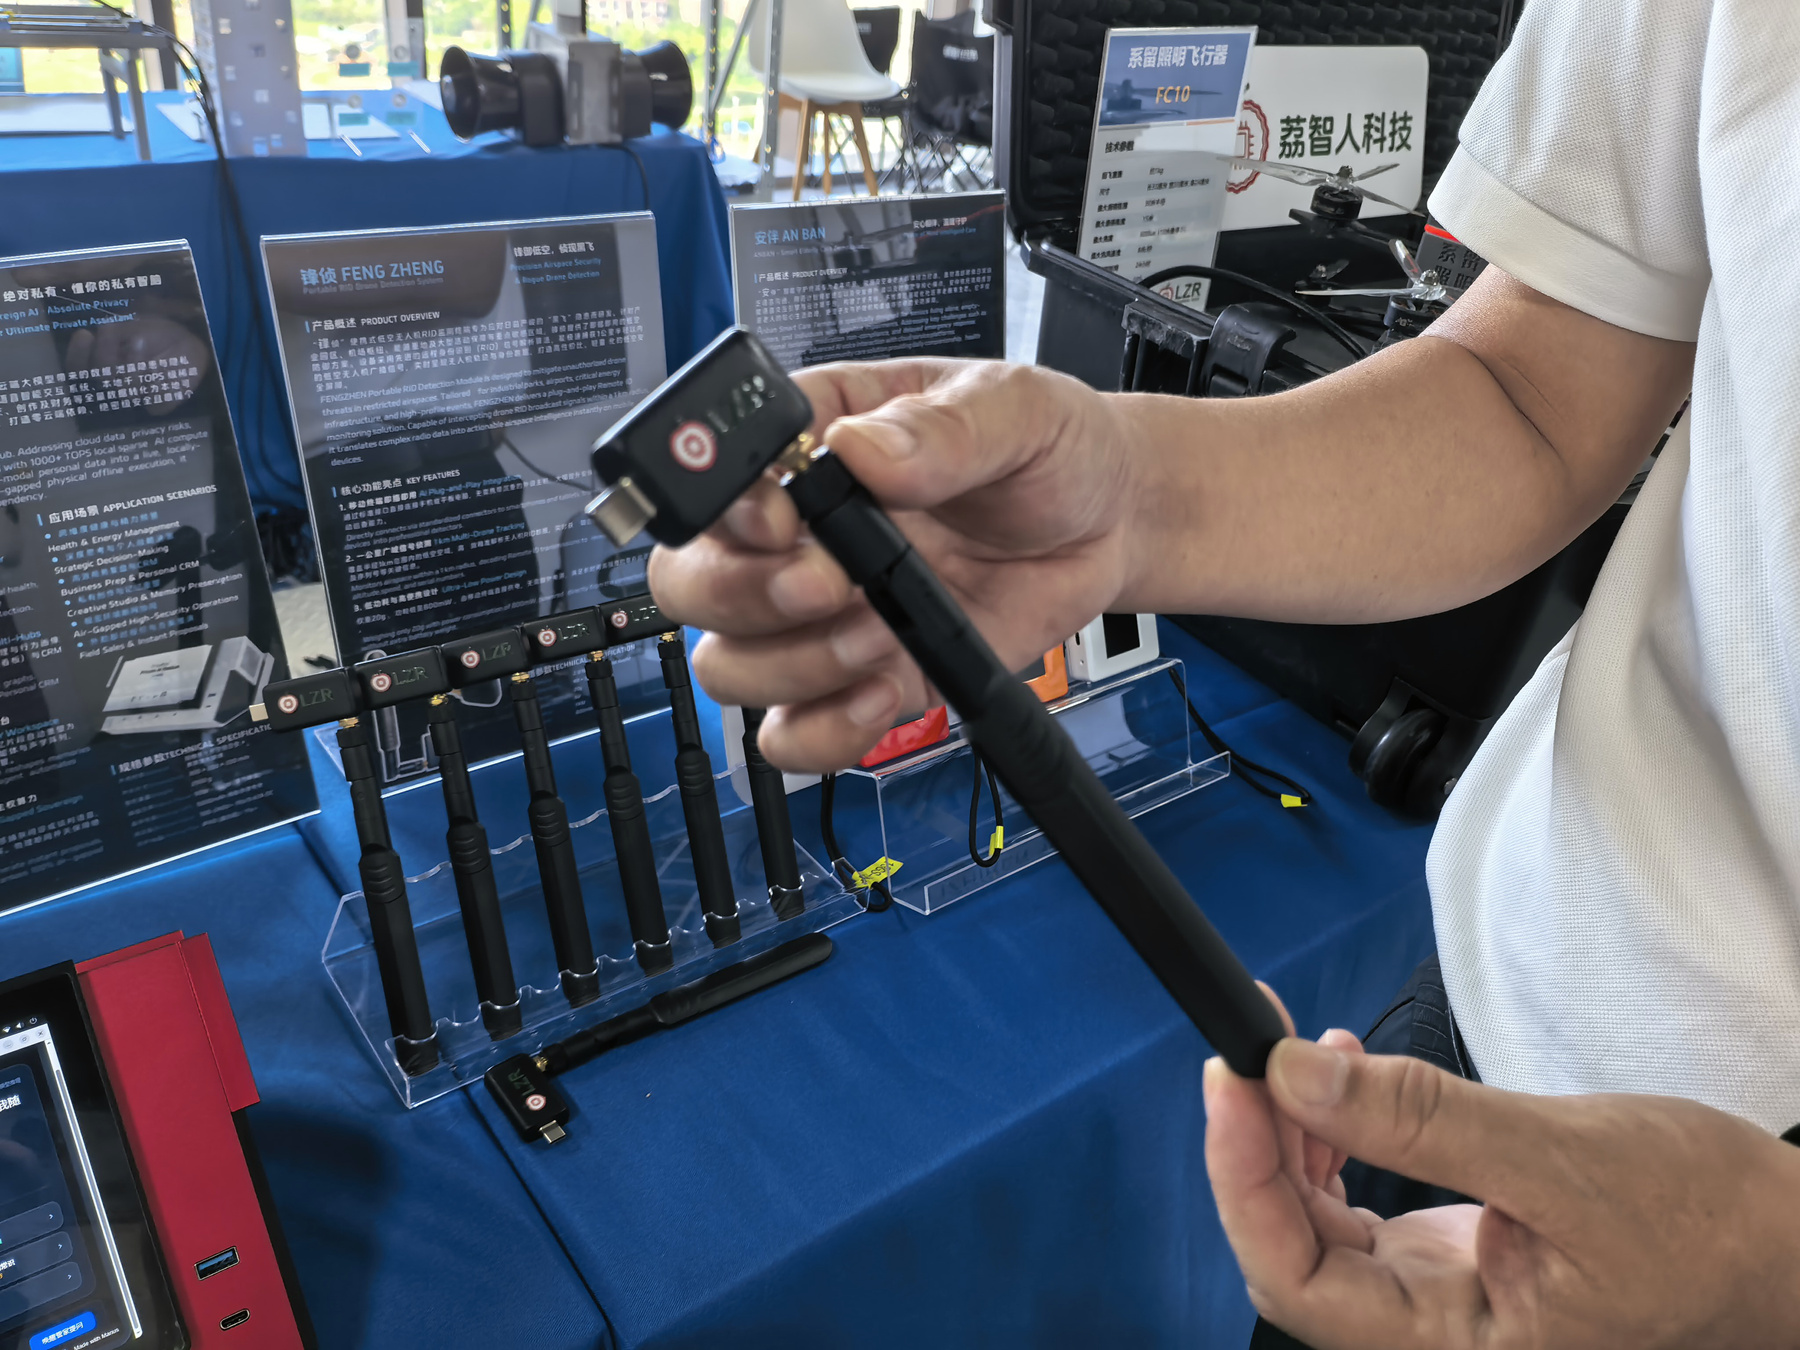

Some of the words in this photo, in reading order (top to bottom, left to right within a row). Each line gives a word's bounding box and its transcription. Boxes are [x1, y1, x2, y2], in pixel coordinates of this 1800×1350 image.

[1127, 44, 1229, 69] 系留照明飞行器
[1155, 85, 1191, 105] FC10
[1278, 110, 1414, 159] 荔智人科技
[755, 229, 779, 245] 安伴
[782, 228, 798, 242] AN
[801, 226, 826, 240] BAN
[300, 267, 338, 287] 锋侦
[341, 264, 386, 282] FENG
[389, 260, 445, 278] ZHENG
[1174, 282, 1202, 300] LZR
[47, 301, 92, 315] Absolute
[5, 324, 51, 337] Ultimate
[52, 317, 88, 331] Private
[312, 317, 357, 332] 产品概述
[360, 315, 398, 327] PRODUCT
[400, 311, 441, 323] OVERVIEW
[138, 372, 165, 384] TOPS
[320, 391, 367, 403] FENGZHEN
[368, 386, 402, 398] Portable
[403, 385, 417, 393] RID
[418, 381, 455, 391] Detection
[456, 377, 483, 386] Module
[322, 406, 353, 417] threats
[363, 400, 400, 412] restricted
[441, 389, 471, 400] Tailored
[384, 412, 399, 421] and
[400, 405, 446, 420] high-profile
[474, 396, 515, 408] FENGZHEN
[547, 383, 597, 398] plug-and-play
[326, 428, 372, 442] monitoring
[407, 419, 437, 431] Capable
[493, 406, 514, 417] drone
[515, 404, 528, 413] RID
[528, 400, 564, 412] broadcast
[3, 460, 28, 472] with
[30, 454, 62, 467] 1000+
[64, 449, 92, 461] TOPS
[93, 444, 117, 456] local
[117, 441, 149, 454] sparse
[167, 430, 209, 445] compute
[17, 441, 73, 457] Addressing
[75, 436, 101, 448] cloud
[103, 432, 126, 443] data
[131, 425, 165, 440] privacy
[337, 439, 377, 453] translates
[378, 436, 411, 448] complex
[411, 431, 431, 442] radio
[432, 429, 450, 439] data
[450, 426, 466, 436] into
[38, 462, 81, 479] personal
[84, 457, 107, 469] data
[110, 453, 130, 466] into
[47, 471, 88, 489] physical
[91, 466, 124, 480] offline
[340, 477, 403, 497] 核心功能亮点
[406, 475, 421, 486] KEY
[423, 469, 461, 483] FEATURES
[49, 504, 100, 524] 应用场景
[103, 493, 164, 514] APPLICATION
[166, 484, 218, 501] SCENARIOS
[48, 540, 78, 553] Health
[91, 531, 123, 545] Energy
[124, 520, 181, 539] Management
[54, 560, 95, 575] Strategic
[96, 544, 169, 566] Decision-Making
[61, 583, 103, 597] Business
[105, 576, 127, 589] Prep
[138, 566, 177, 580] Personal
[178, 559, 200, 571] CRM
[67, 603, 107, 618] Creative
[108, 596, 139, 609] Studio
[150, 584, 187, 600] Memory
[187, 572, 243, 591] Preservation
[73, 619, 127, 639] Air-Gapped
[128, 604, 190, 625] High-Security
[192, 593, 240, 611] Operations
[558, 622, 591, 643] LZR
[80, 647, 101, 660] Field
[102, 643, 126, 656] Sales
[480, 641, 513, 663] LZR
[551, 656, 588, 671] TECHNICAL
[38, 677, 60, 689] CRM
[391, 665, 429, 686] LZR
[299, 687, 334, 716] LZR
[5, 718, 60, 738] Workspace
[165, 739, 215, 761] TECHNICAL
[508, 1067, 536, 1097] LZR
[73, 1339, 90, 1350] Made
[101, 1326, 120, 1340] Manus
